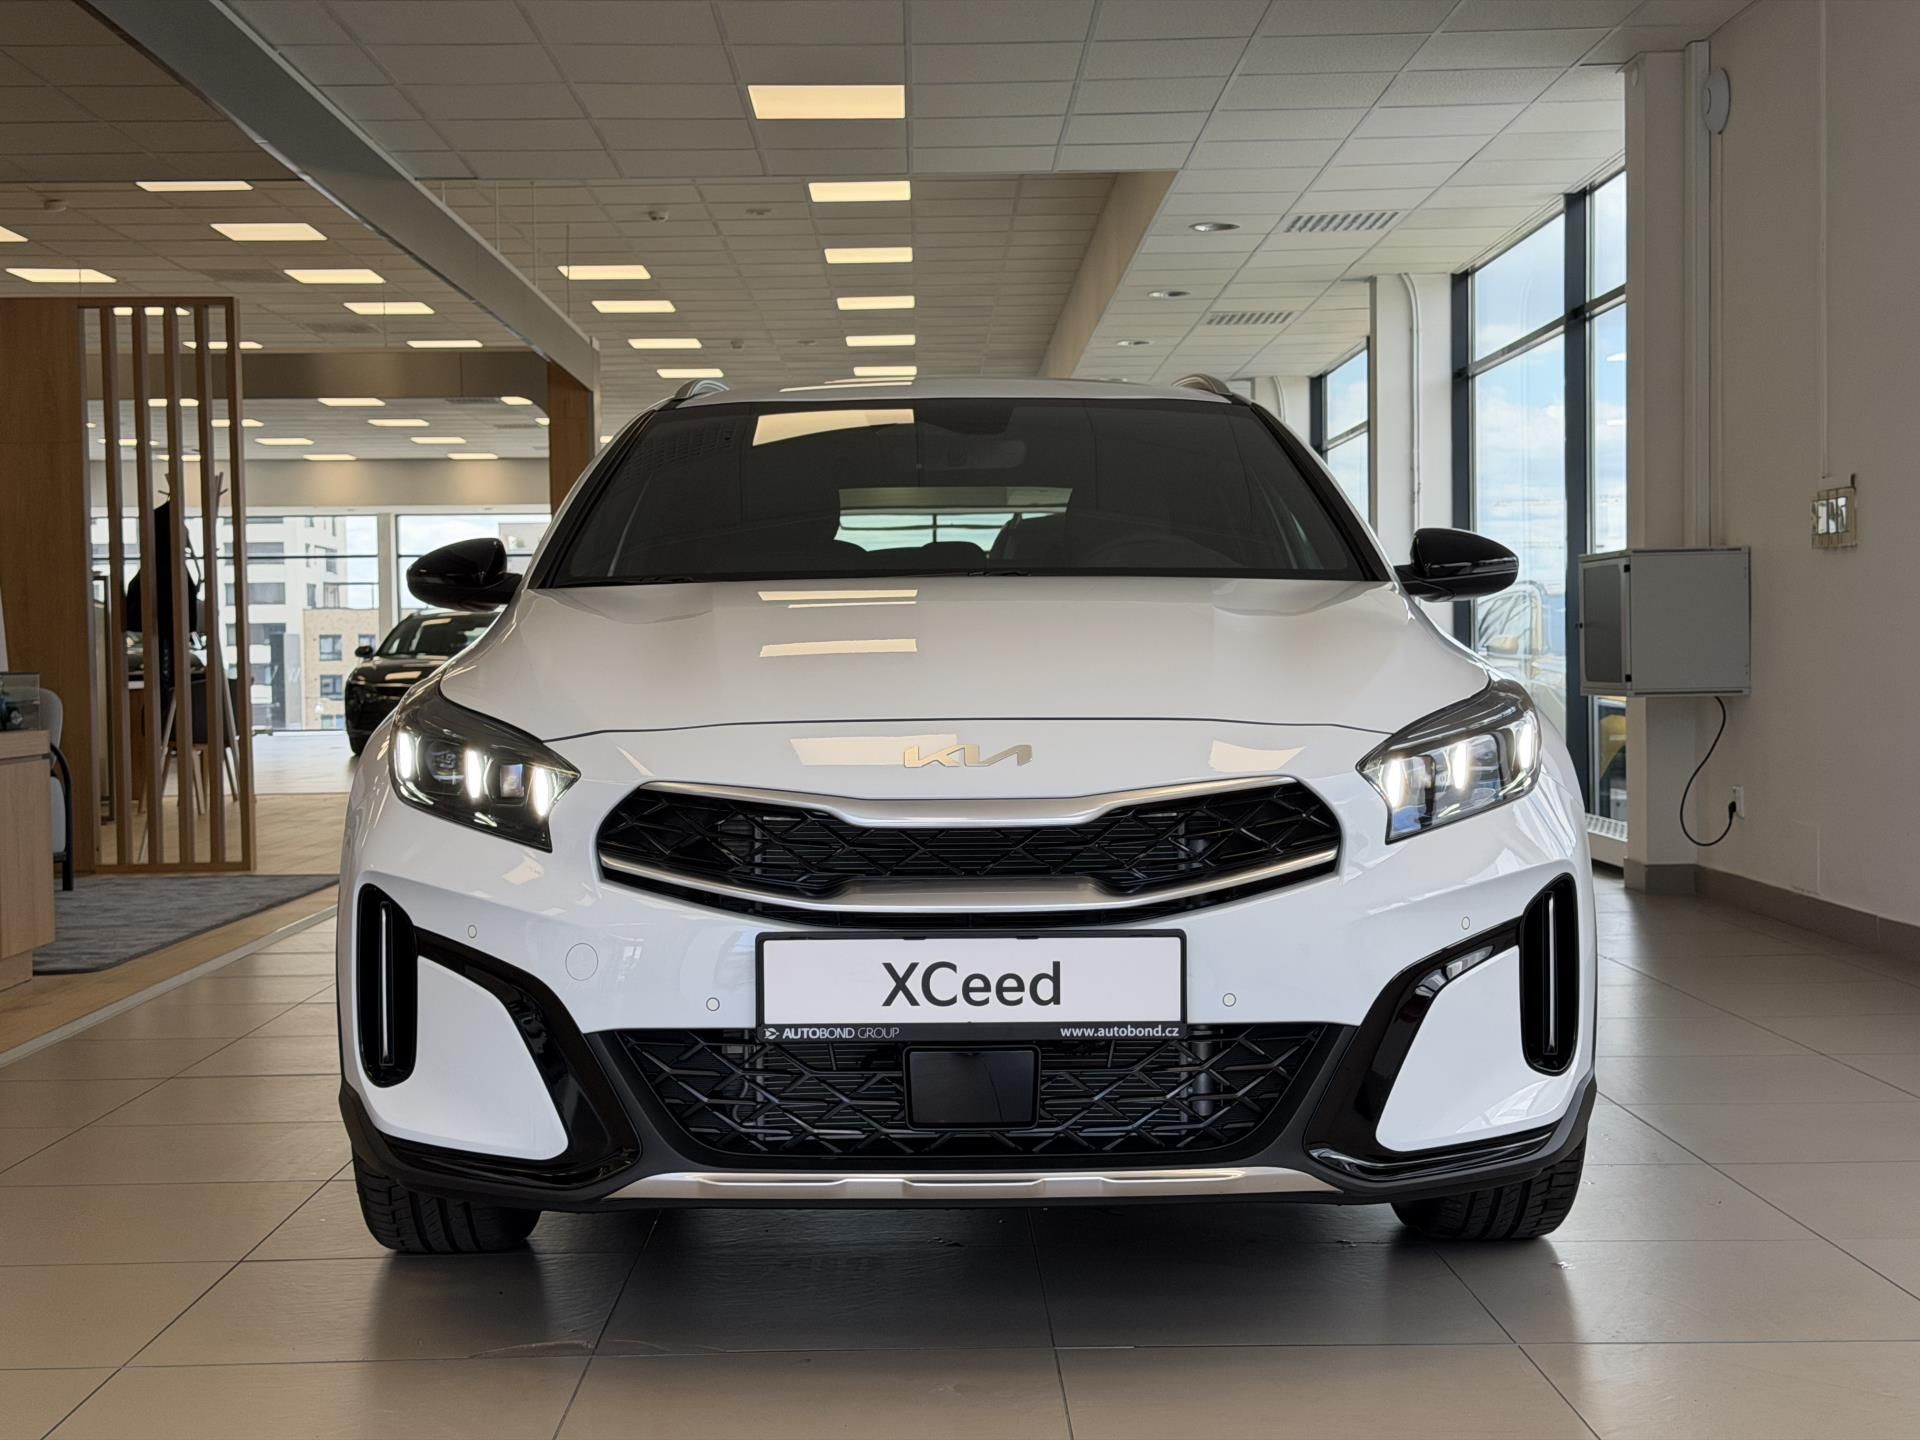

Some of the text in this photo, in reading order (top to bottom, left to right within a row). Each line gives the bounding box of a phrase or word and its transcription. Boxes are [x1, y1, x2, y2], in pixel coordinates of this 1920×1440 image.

[904, 744, 1033, 768] KIA
[882, 961, 1061, 1007] XCeed
[782, 1026, 900, 1040] AUTOBOND GROUP
[1060, 1024, 1180, 1037] www.autobond.cz
